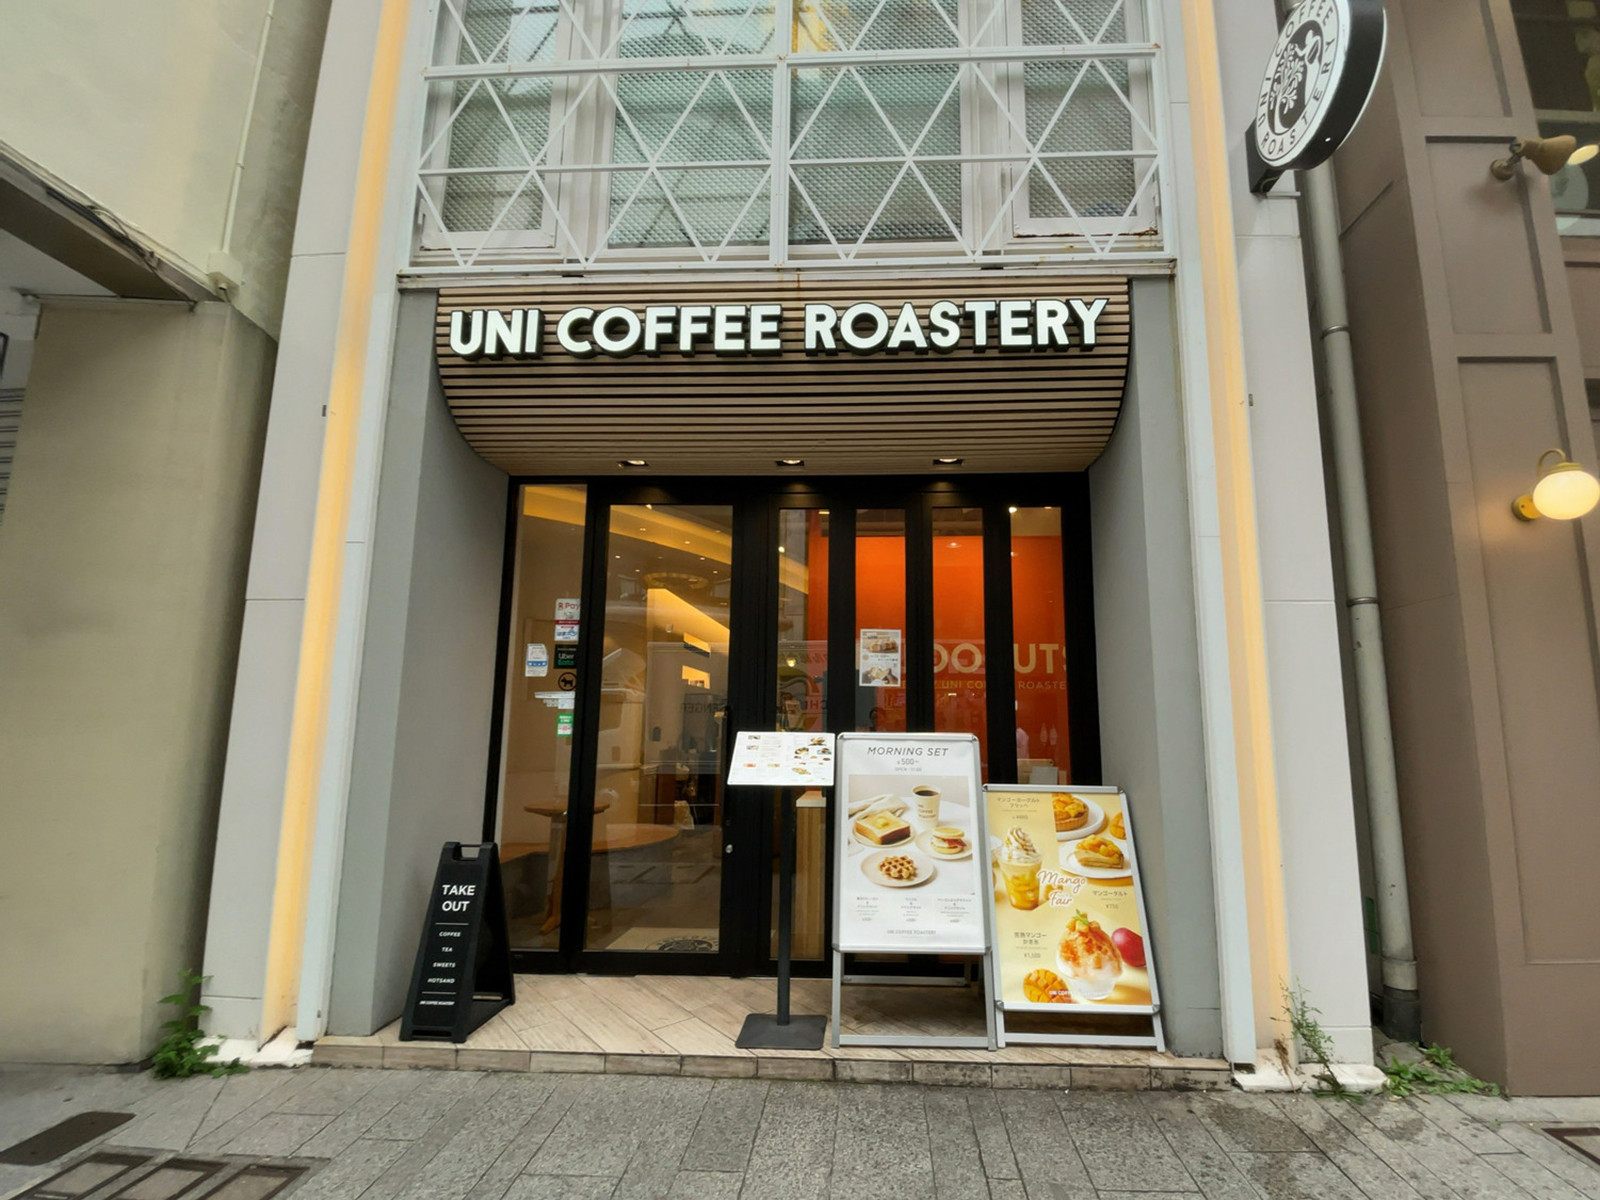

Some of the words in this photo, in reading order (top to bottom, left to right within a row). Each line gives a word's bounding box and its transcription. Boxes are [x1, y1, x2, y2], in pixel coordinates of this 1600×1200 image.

[1258, 76, 1272, 127] UNI
[1275, 0, 1333, 57] COFFEE
[1260, 37, 1336, 154] ROASTERY
[449, 308, 541, 356] UNI
[557, 304, 782, 354] COFFEE
[805, 298, 1110, 350] ROASTERY
[1018, 679, 1066, 690] ROASTE
[867, 746, 923, 756] MORNING
[927, 747, 949, 757] SET
[1037, 870, 1086, 894] Mango
[442, 885, 476, 896] TAKE
[1049, 890, 1073, 906] Fair
[441, 900, 470, 912] OUT
